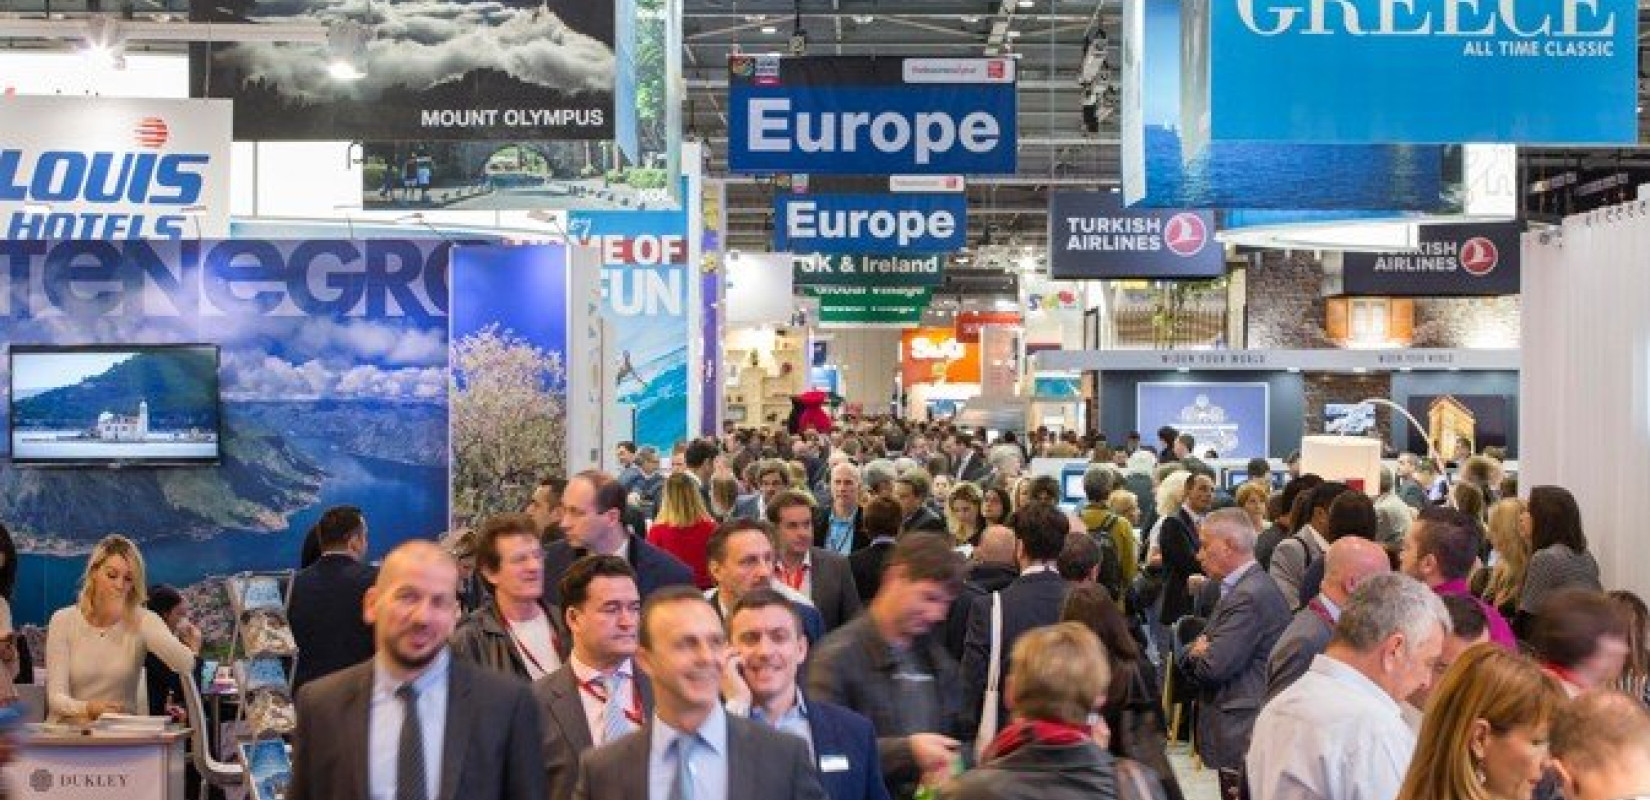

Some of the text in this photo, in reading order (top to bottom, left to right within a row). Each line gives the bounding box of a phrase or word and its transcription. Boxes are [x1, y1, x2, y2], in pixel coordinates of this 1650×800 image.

[1463, 41, 1615, 57] ALL TIME CLASSIC
[420, 109, 605, 127] MOUNT OLYMPUS
[747, 97, 1000, 165] Europe
[0, 149, 210, 204] LOUIS
[7, 212, 188, 240] HOTELS
[786, 201, 956, 246] Europe
[1066, 217, 1161, 233] TURKISH
[632, 234, 684, 265] OF
[1066, 234, 1161, 251] AIRLINES
[840, 255, 856, 273] &
[862, 256, 938, 273] Ireland
[1374, 256, 1457, 271] AIRLINES
[60, 773, 129, 788] DUKLEY
